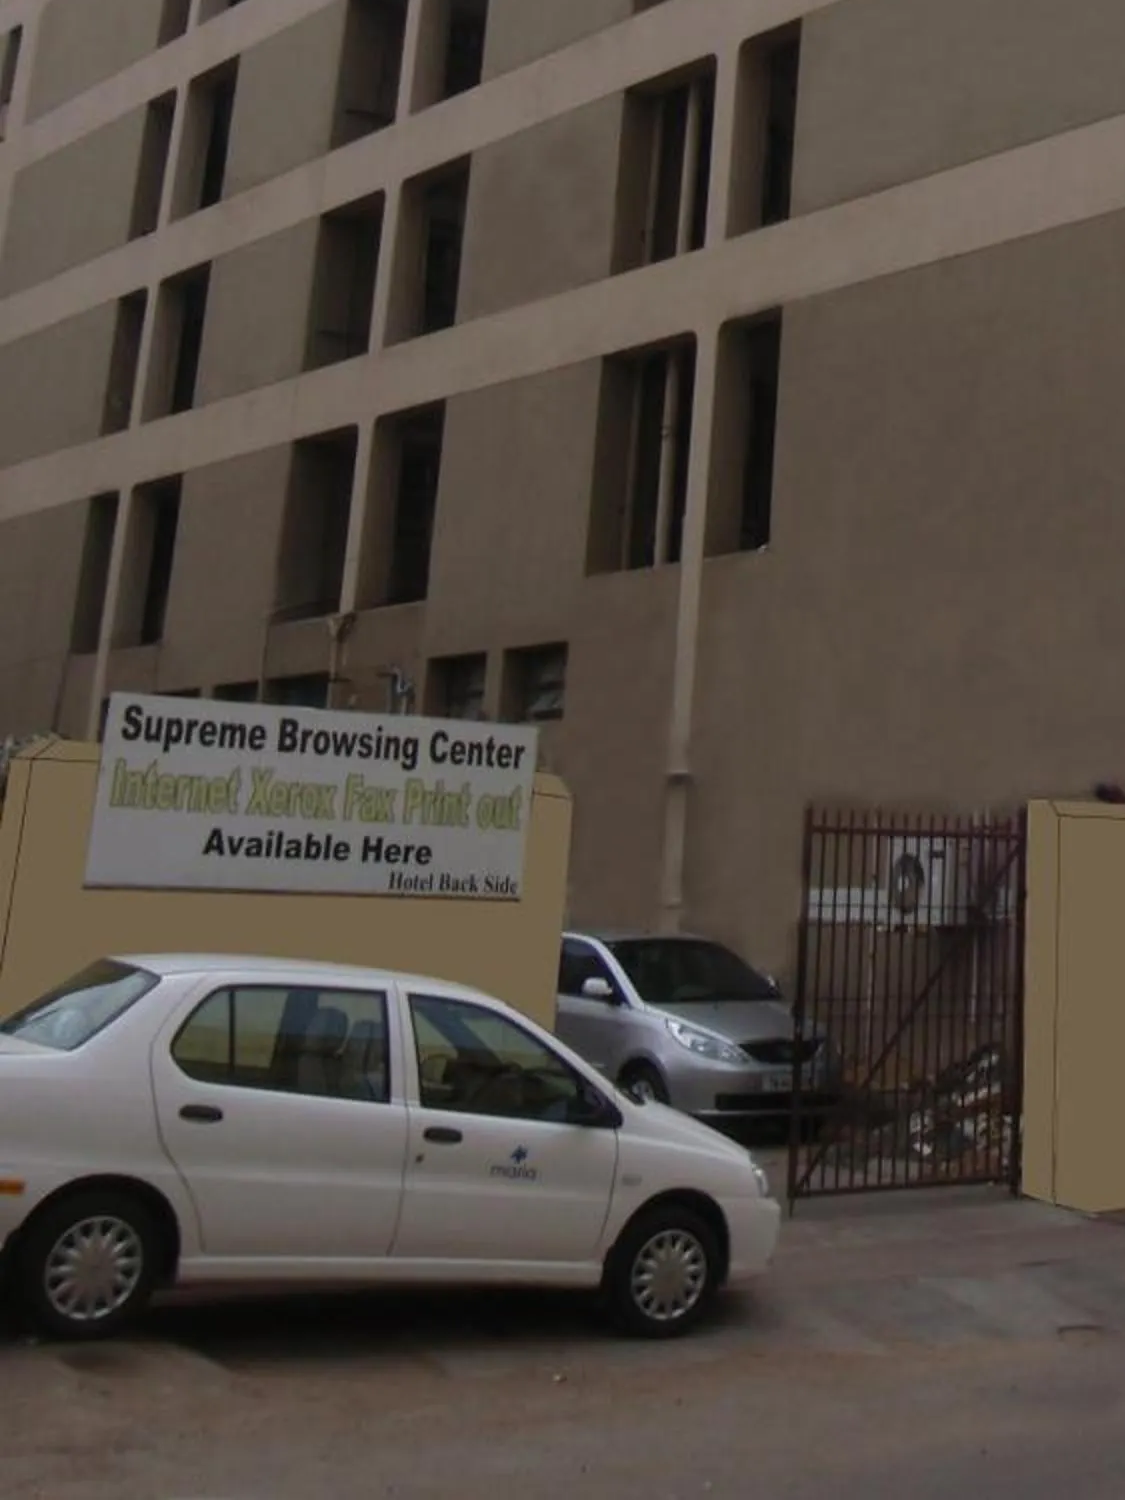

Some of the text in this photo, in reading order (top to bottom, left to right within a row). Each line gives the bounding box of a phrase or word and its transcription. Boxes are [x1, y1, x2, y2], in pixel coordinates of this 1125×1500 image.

[121, 705, 525, 770] Supreme Browsing Center
[109, 758, 522, 832] Internet Xerox Fax Print out
[203, 827, 433, 866] Available Here
[389, 871, 519, 897] Hotel Back Side
